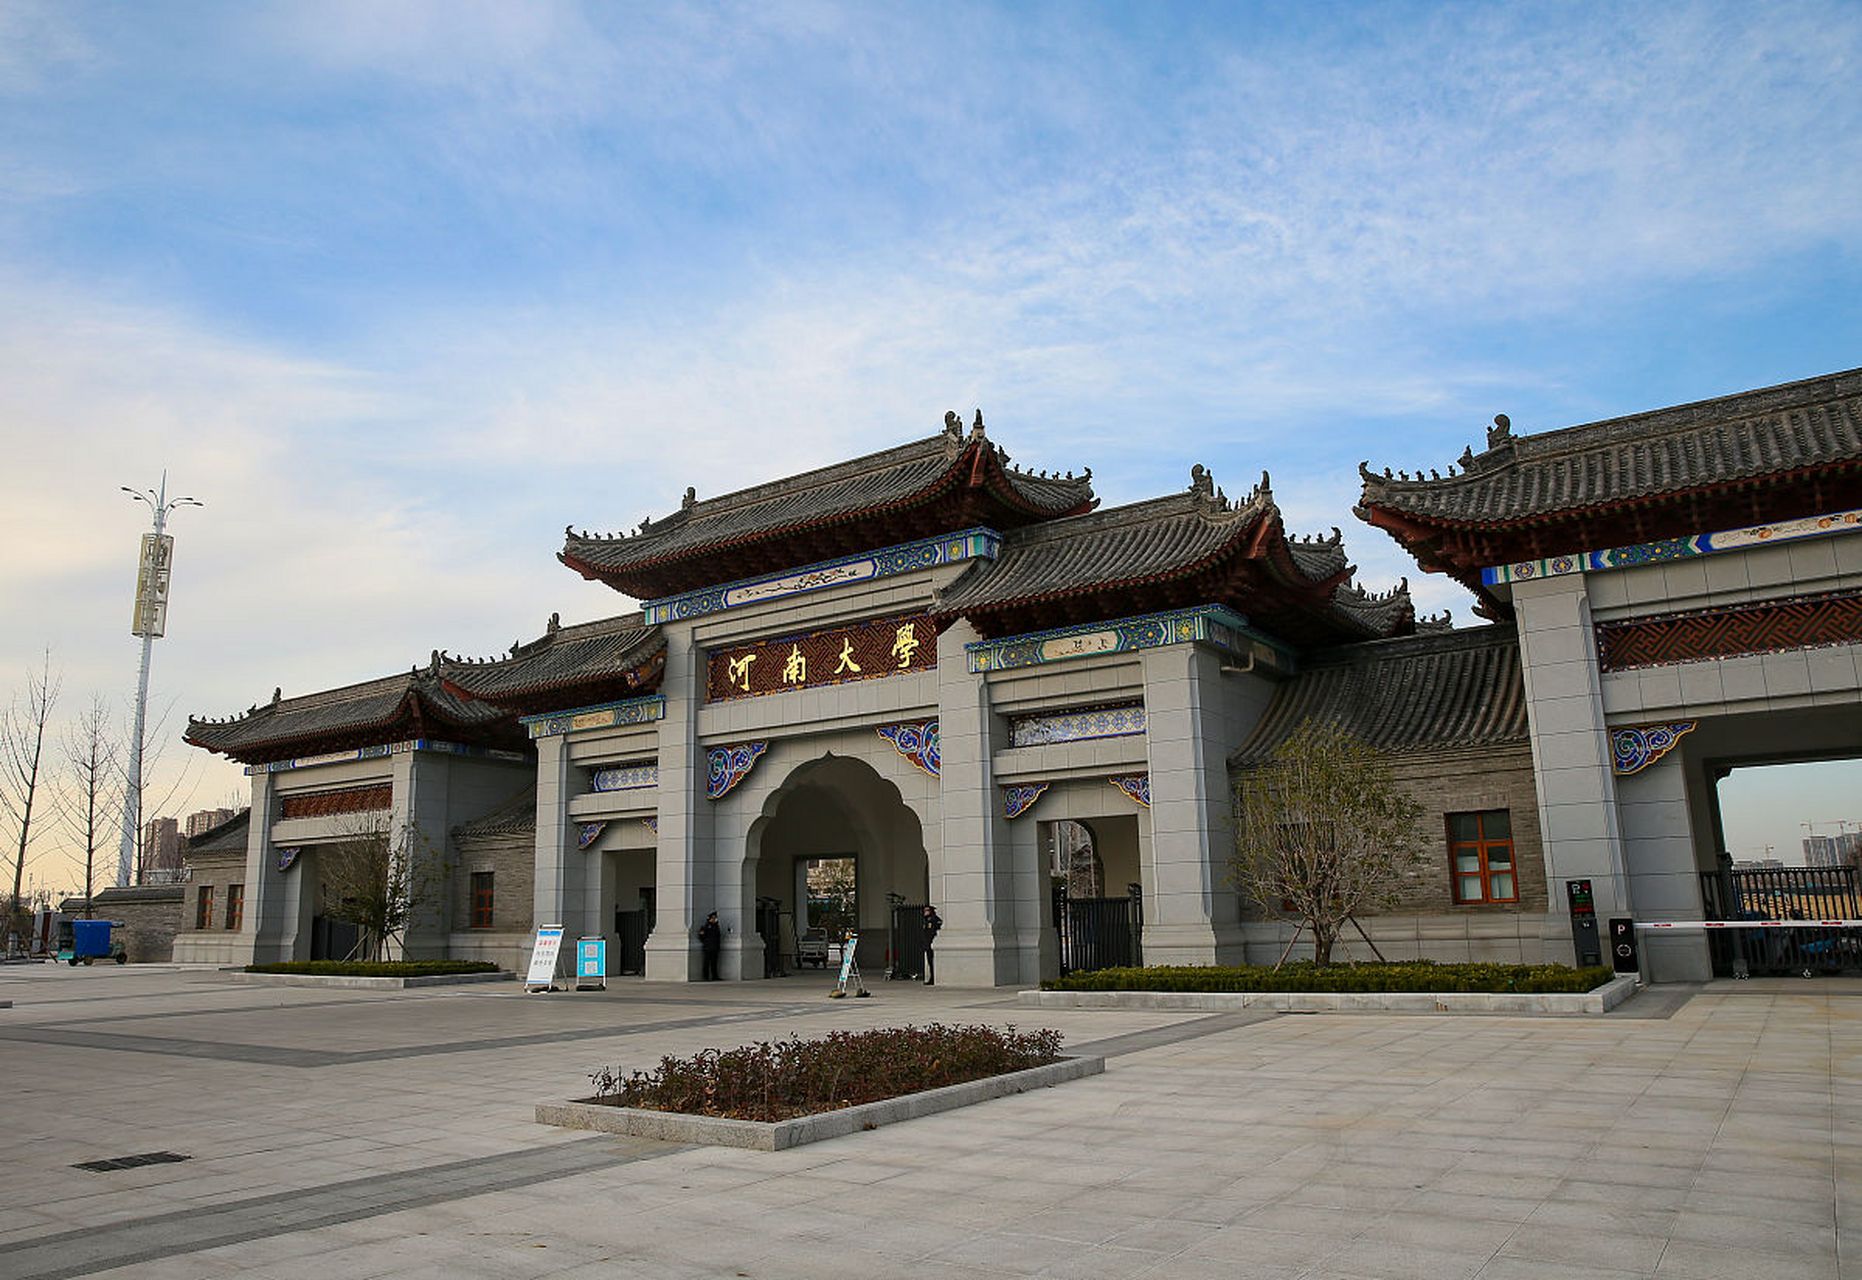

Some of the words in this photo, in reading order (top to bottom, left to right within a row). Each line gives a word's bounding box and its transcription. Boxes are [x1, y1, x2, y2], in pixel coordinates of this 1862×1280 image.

[728, 623, 919, 691] 河南大學
[1617, 924, 1625, 934] P
